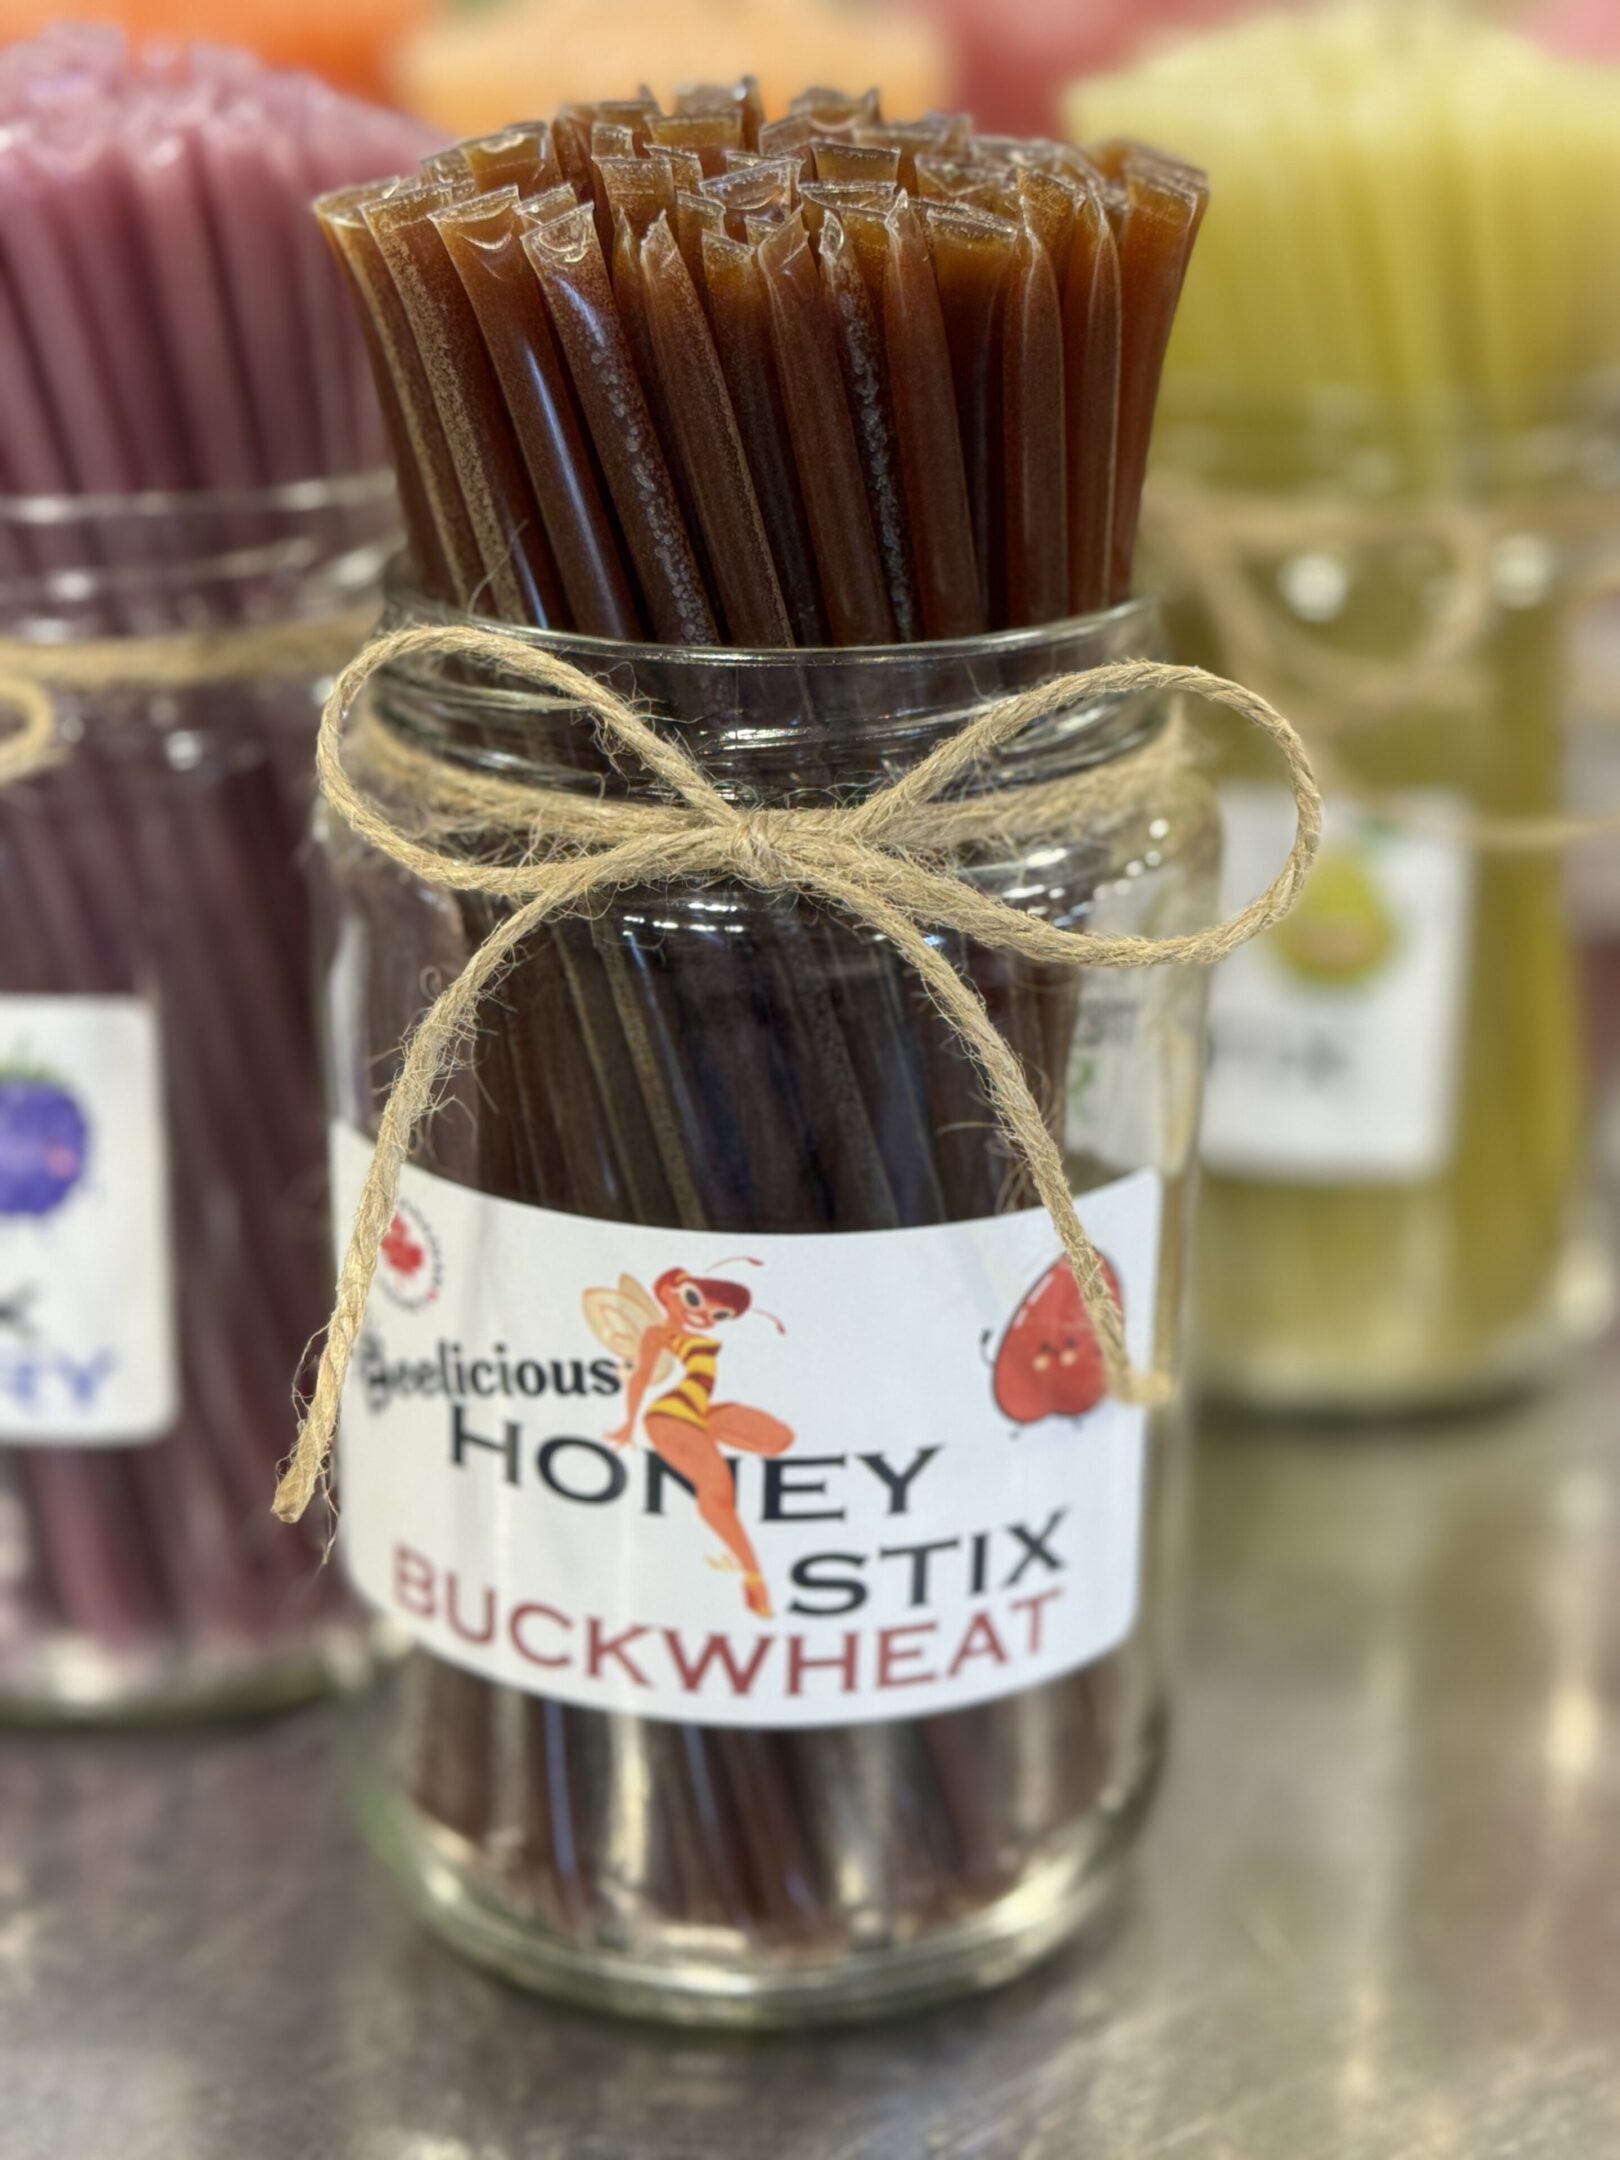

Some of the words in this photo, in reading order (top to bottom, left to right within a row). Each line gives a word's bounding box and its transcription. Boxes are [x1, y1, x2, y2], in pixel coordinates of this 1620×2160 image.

[450, 1403, 945, 1523] HONEY
[392, 1541, 1064, 1697] BUCKWHEAT
[787, 1505, 1068, 1617] STIX
